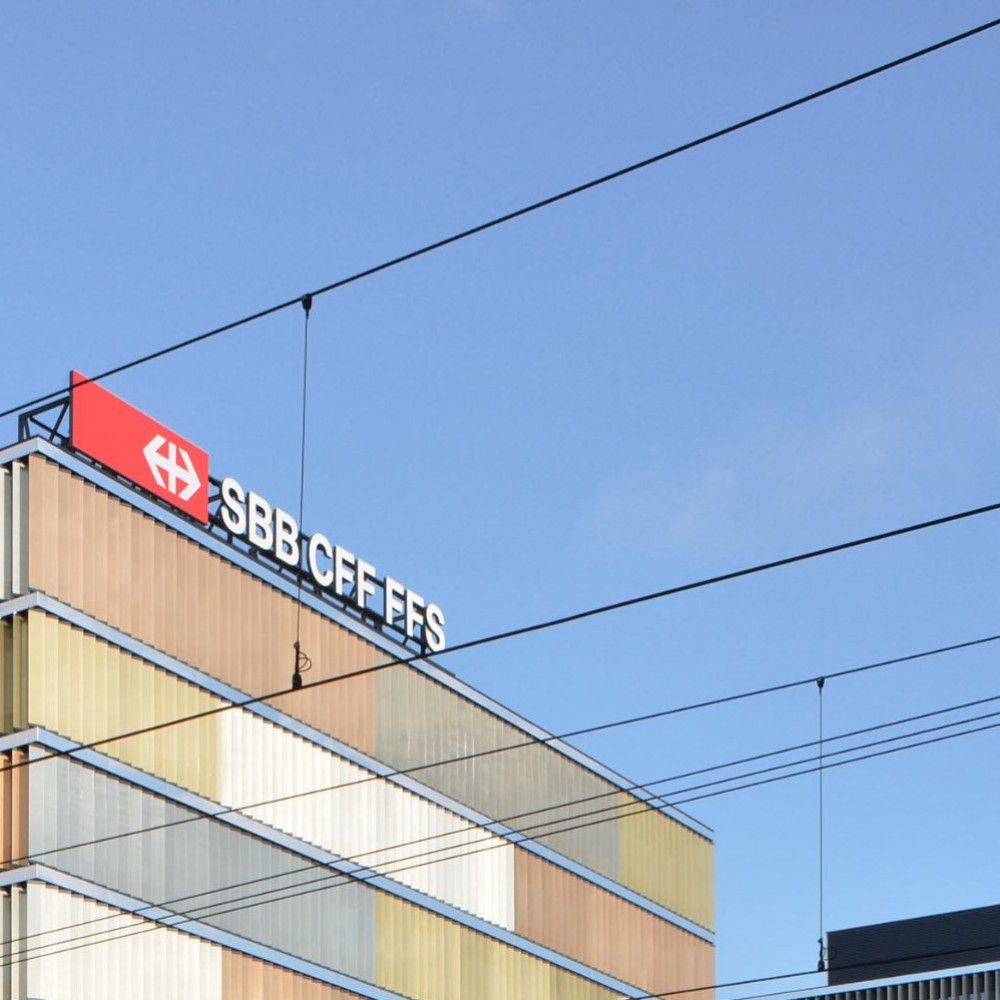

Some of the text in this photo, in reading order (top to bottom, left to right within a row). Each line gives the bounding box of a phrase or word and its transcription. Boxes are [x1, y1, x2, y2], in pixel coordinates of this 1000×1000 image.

[220, 477, 446, 652] SBB CFF FFS
